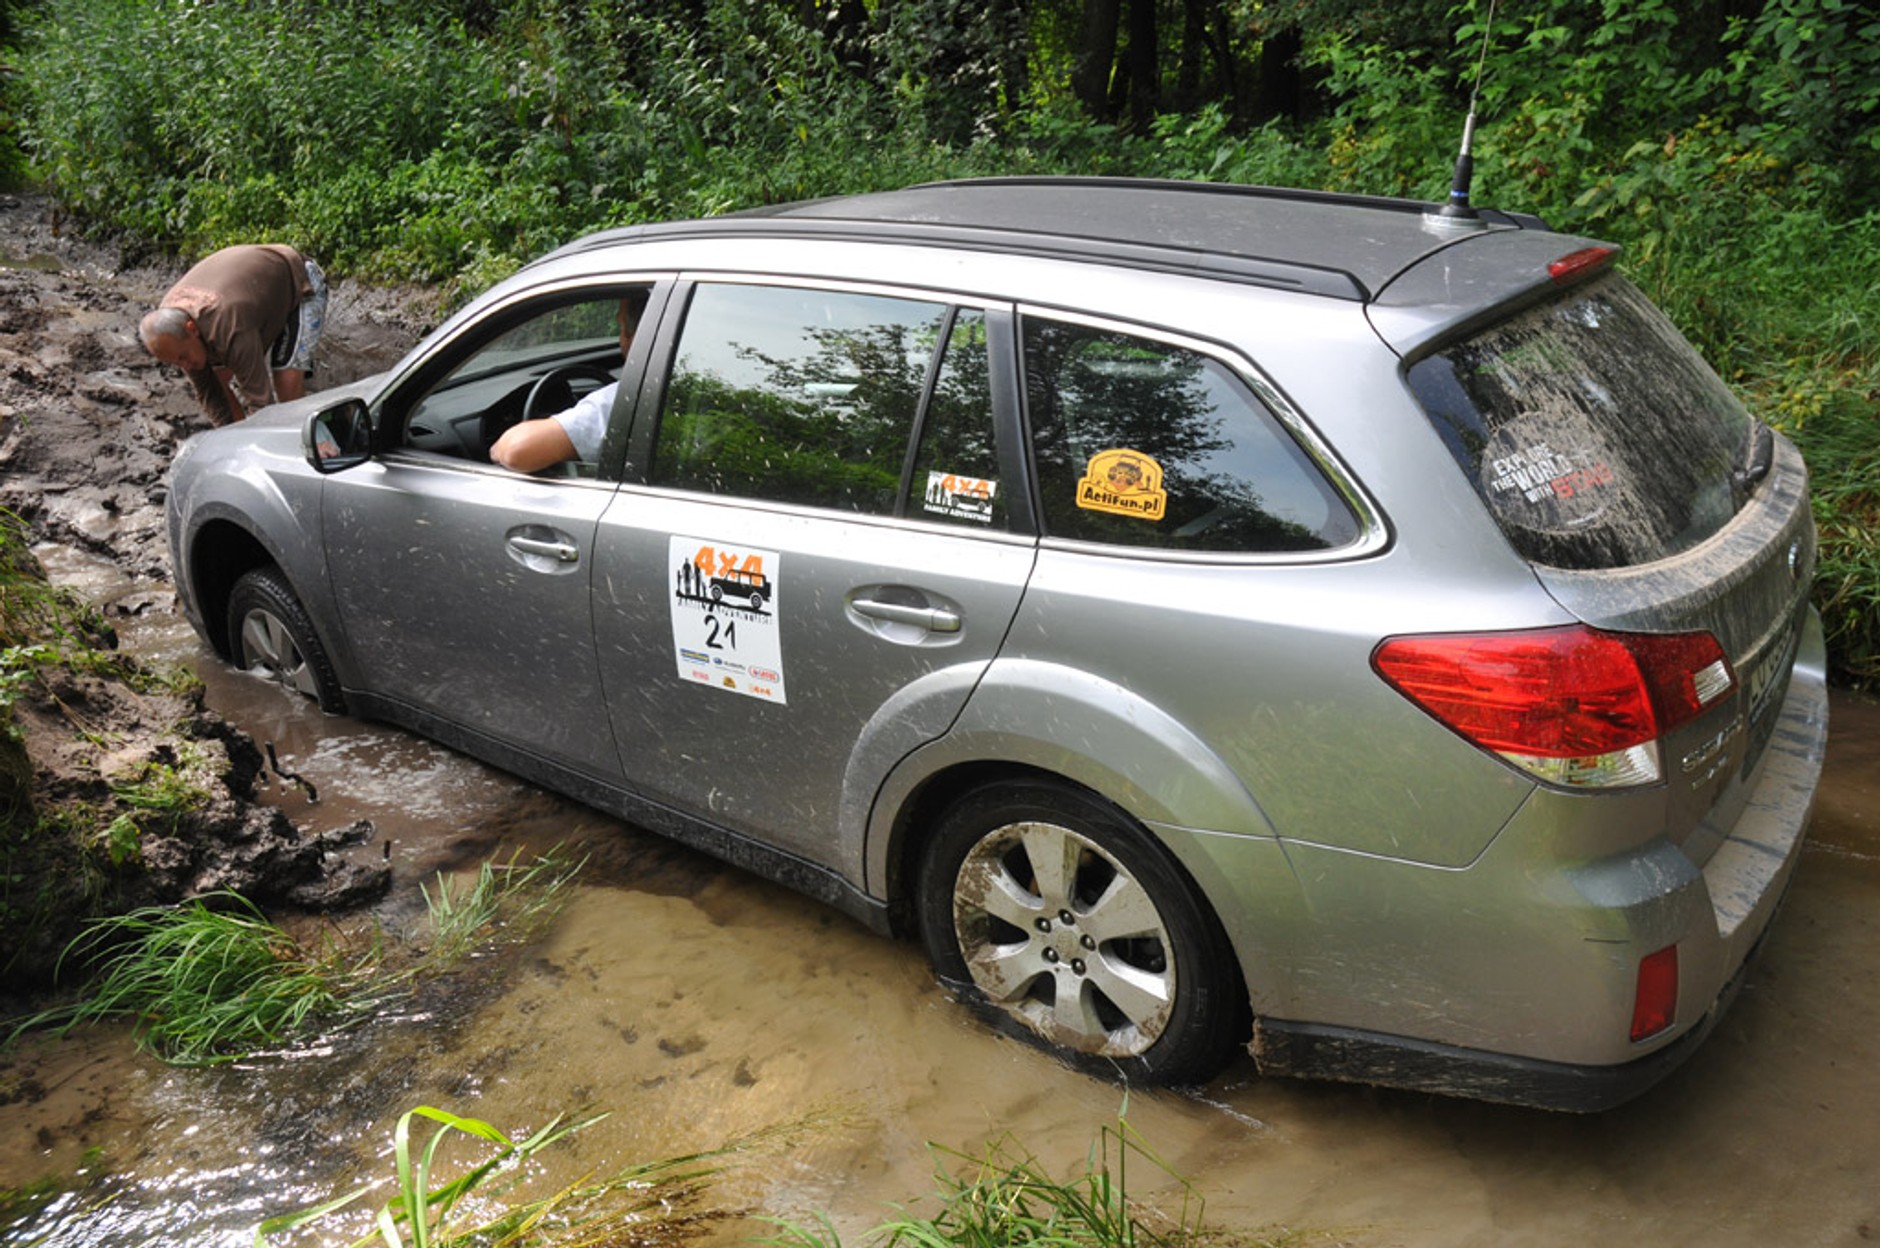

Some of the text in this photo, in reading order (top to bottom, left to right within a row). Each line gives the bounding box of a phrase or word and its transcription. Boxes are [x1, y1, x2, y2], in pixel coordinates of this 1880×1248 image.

[1491, 454, 1573, 493] THE WORLD
[1083, 487, 1159, 512] Actifun.pl
[704, 614, 737, 650] 21
